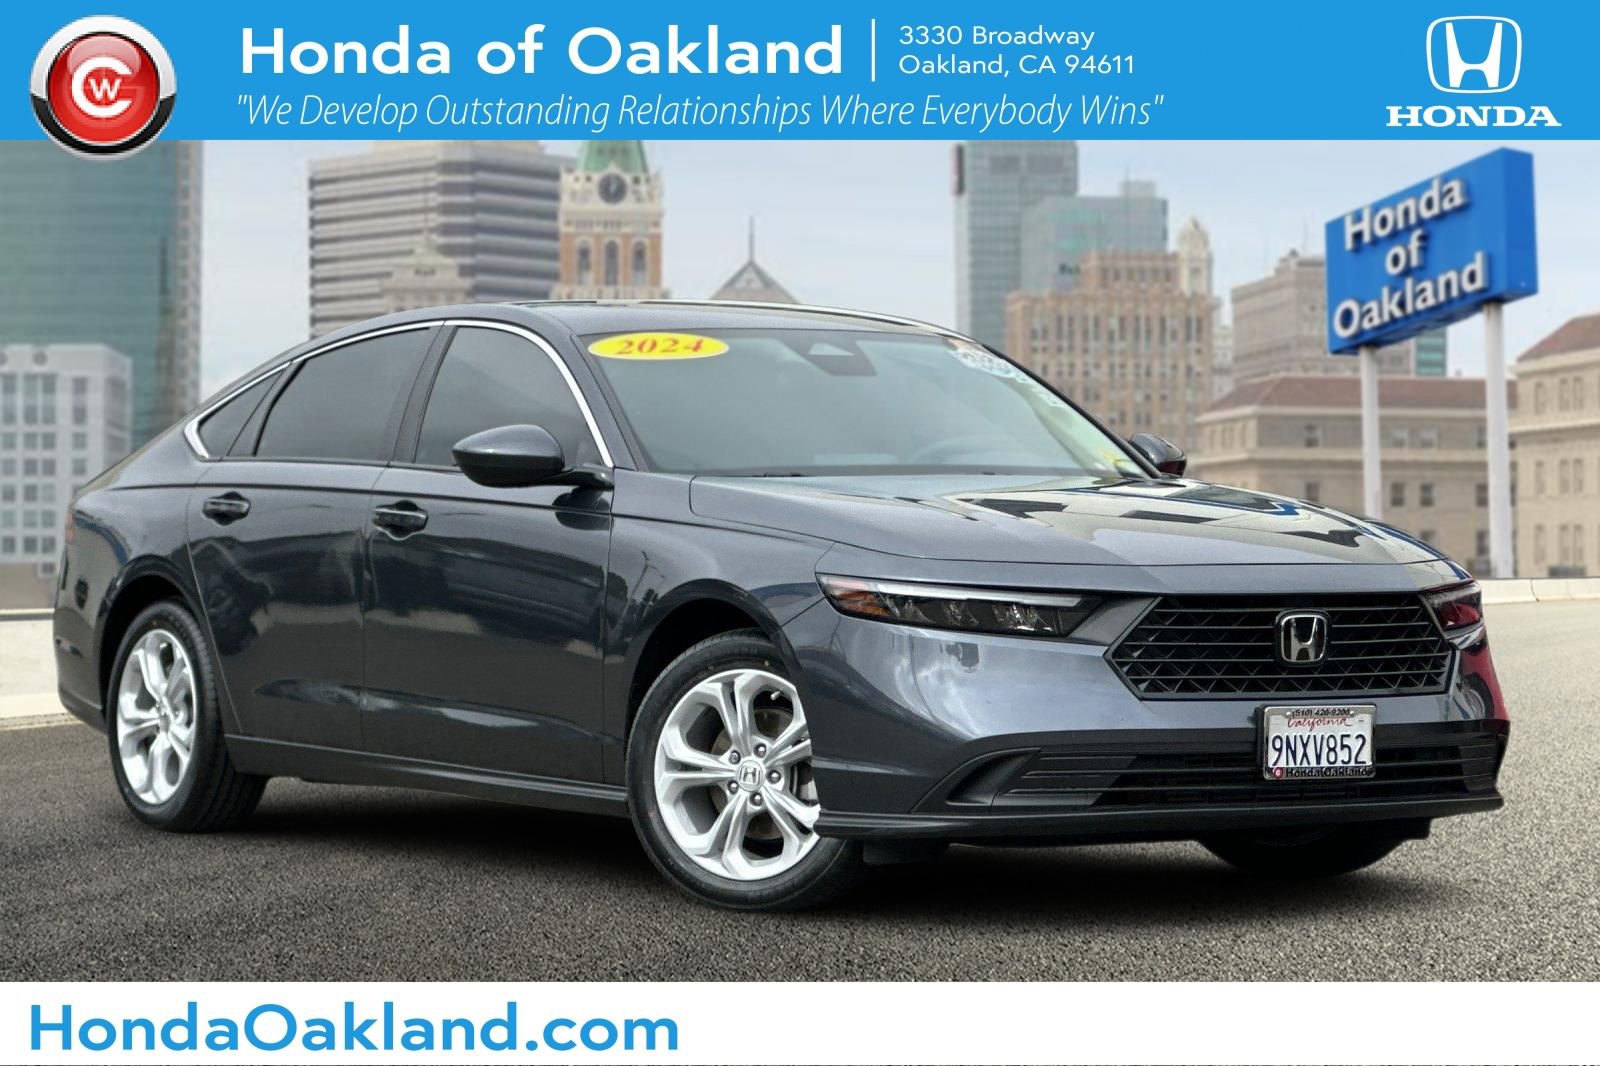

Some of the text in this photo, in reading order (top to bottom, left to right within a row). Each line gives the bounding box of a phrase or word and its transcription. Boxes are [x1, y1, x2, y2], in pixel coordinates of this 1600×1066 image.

[1343, 177, 1467, 252] Honda
[1384, 228, 1427, 276] of
[1332, 250, 1488, 339] Oakland
[616, 338, 704, 355] 2024
[1287, 717, 1353, 731] California
[1292, 709, 1312, 718] (510)
[1271, 733, 1367, 767] 9NXV852
